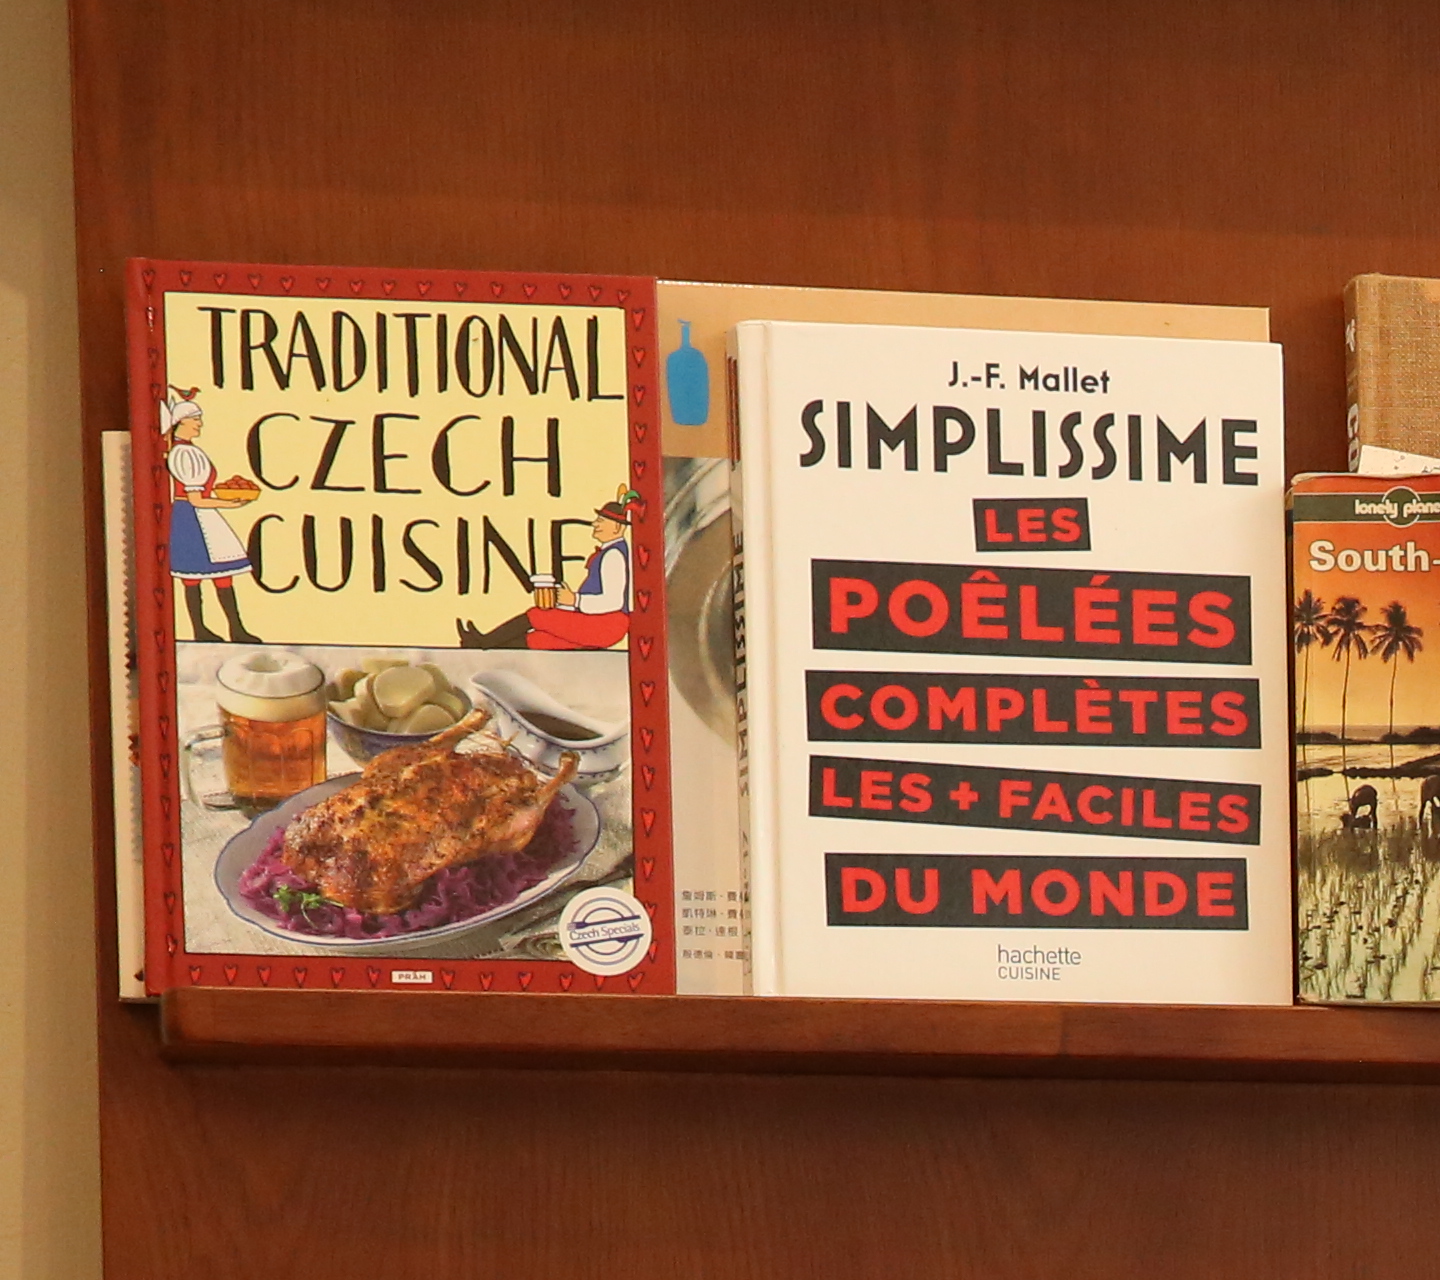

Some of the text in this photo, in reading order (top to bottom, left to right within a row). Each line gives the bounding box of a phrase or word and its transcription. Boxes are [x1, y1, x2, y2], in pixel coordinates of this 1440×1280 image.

[198, 306, 625, 402] TRADITIONAL
[948, 361, 1110, 395] J.-F. Mallet
[246, 413, 563, 498] CZECH
[800, 398, 1259, 487] SIMPLISSIME
[985, 507, 1082, 544] LES
[1355, 498, 1398, 519] lonely
[828, 570, 1237, 650] POÊLÉES
[820, 678, 1248, 738] COMPLÈTES
[821, 769, 933, 814] LES
[999, 780, 1250, 835] FACILES
[841, 867, 1235, 919] DU MONDE
[569, 923, 640, 941] Czech Specials
[997, 945, 1082, 968] hachette
[997, 967, 1061, 982] CUISINE
